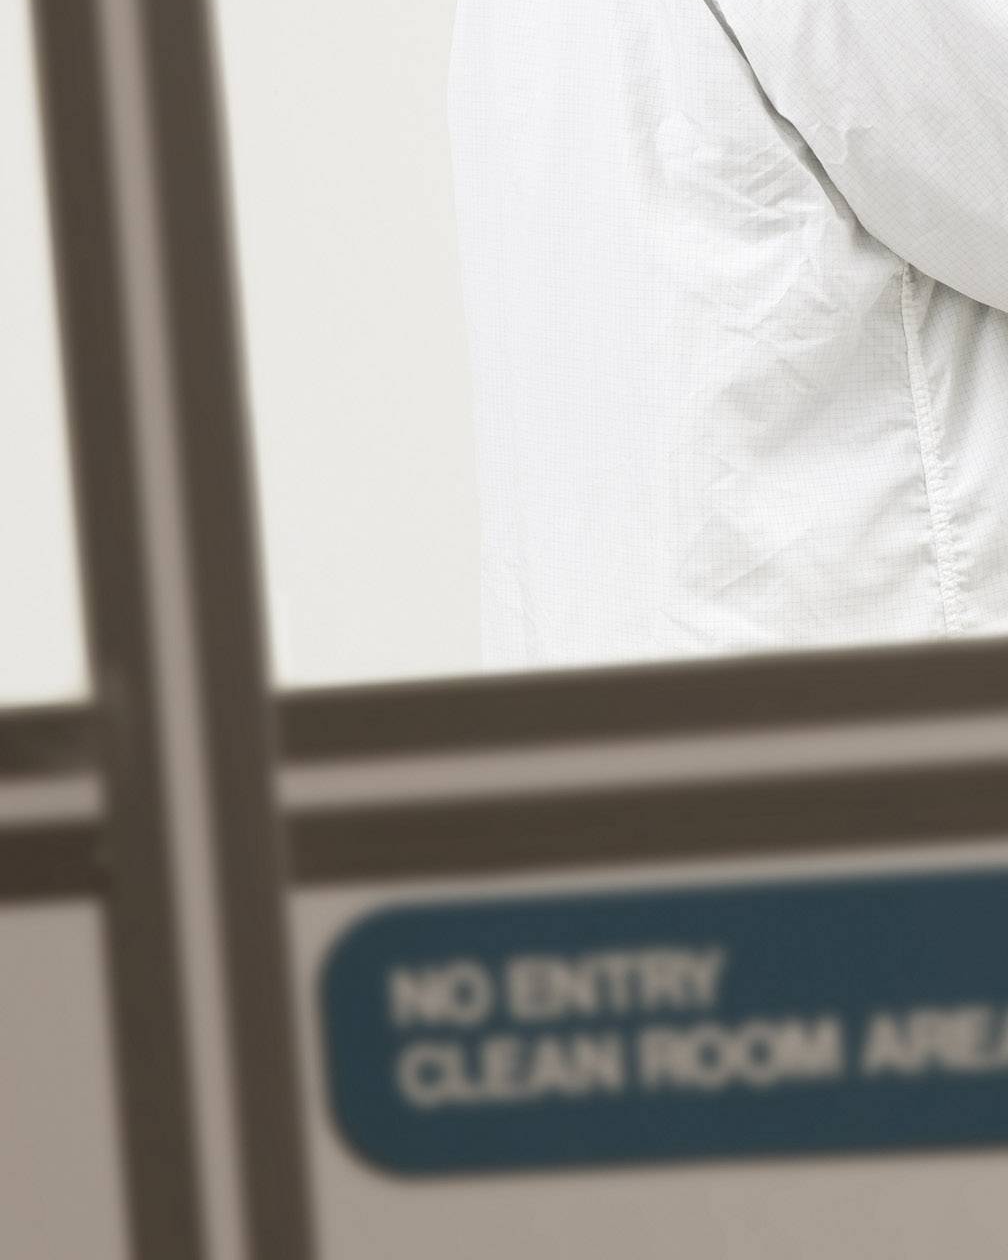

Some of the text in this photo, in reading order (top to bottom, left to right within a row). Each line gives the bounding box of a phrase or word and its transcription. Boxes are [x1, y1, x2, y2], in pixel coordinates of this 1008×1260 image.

[391, 949, 724, 1024] NO ENTRY
[399, 1034, 623, 1107] CLEAN
[640, 1015, 840, 1091] ROOM
